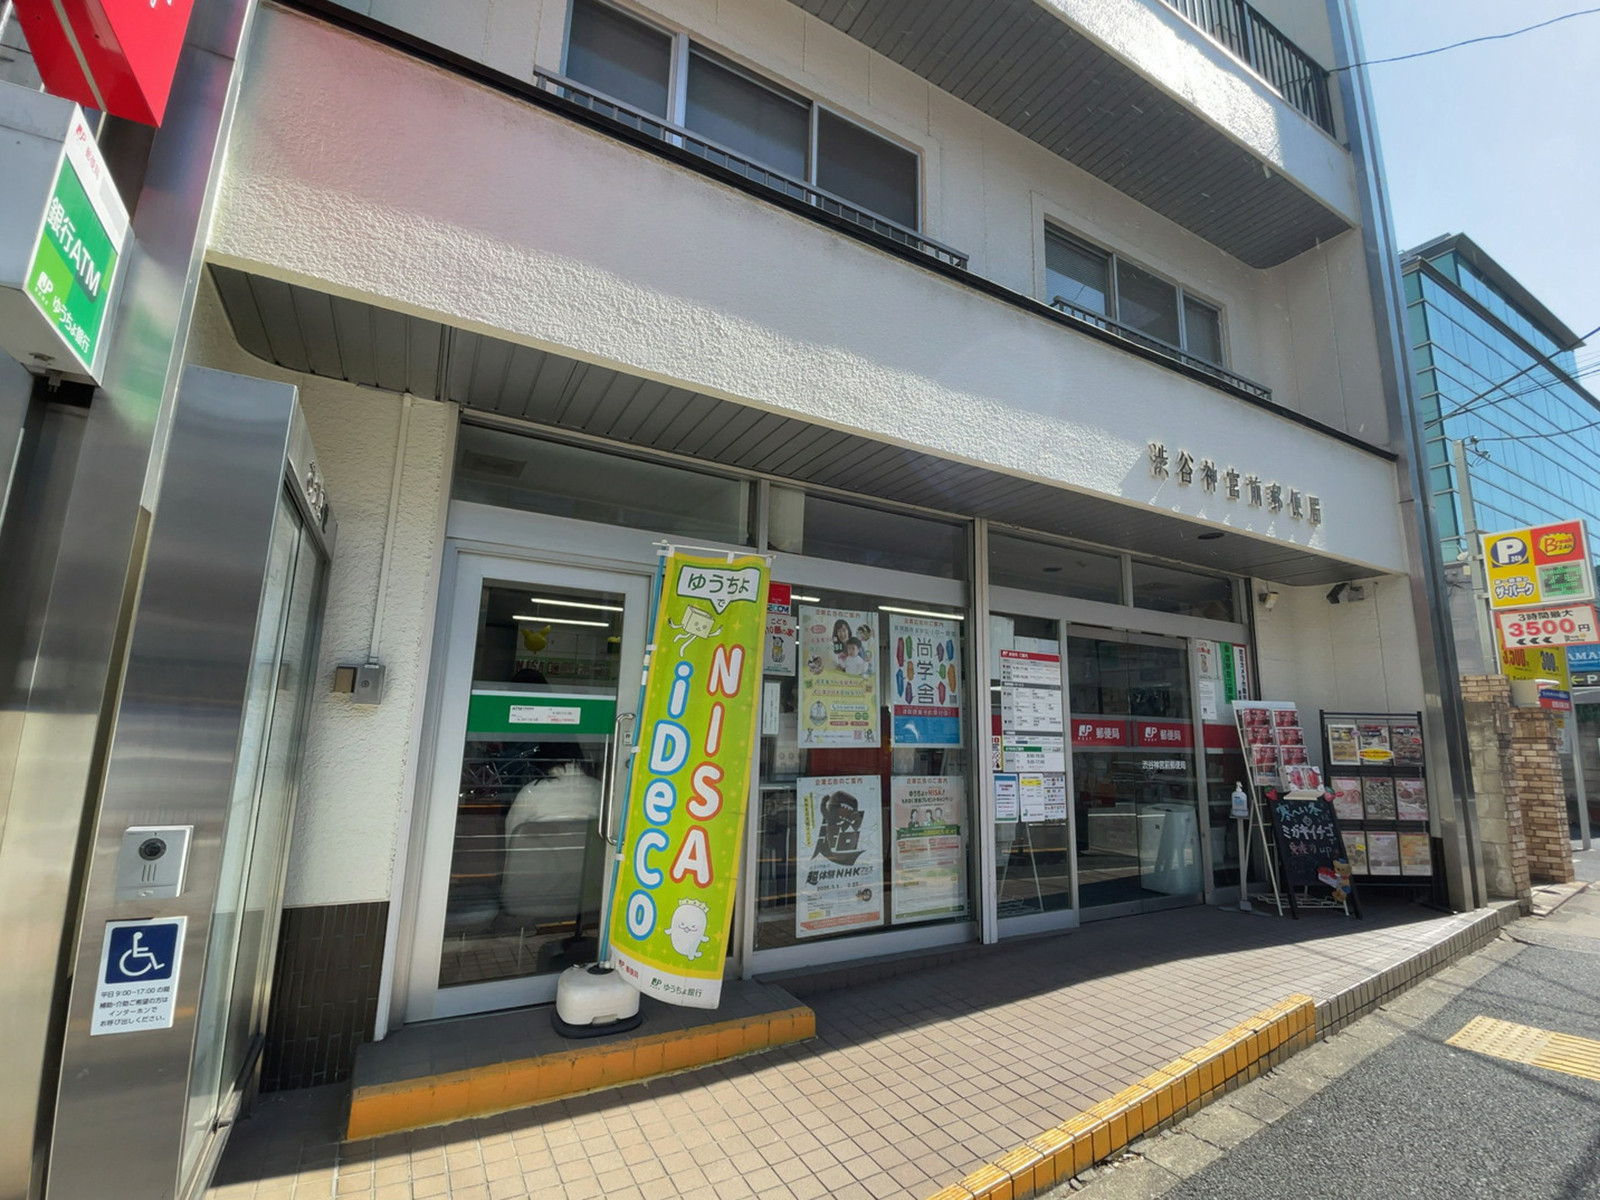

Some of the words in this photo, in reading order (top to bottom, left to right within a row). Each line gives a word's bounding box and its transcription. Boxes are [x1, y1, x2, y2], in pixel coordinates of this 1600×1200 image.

[47, 196, 102, 297] 銀行ATM
[52, 295, 91, 355] ゆうちょ銀行
[1148, 442, 1322, 526] 渋谷神宮前郵便局
[1496, 538, 1524, 564] P
[687, 573, 751, 595] ゆうちょ
[1518, 609, 1574, 621] 3時間最大
[916, 637, 935, 705] 尚学舎
[1587, 674, 1598, 685] P
[1096, 727, 1120, 739] 郵便局
[1160, 729, 1182, 741] 郵便局
[669, 643, 746, 889] NISA
[625, 661, 695, 941] iDeCo
[102, 991, 114, 999] 平日
[663, 983, 703, 998] ゆうちょ銀行
[109, 1007, 158, 1016] インターホンで
[100, 1016, 165, 1027] お呼び出しください。
